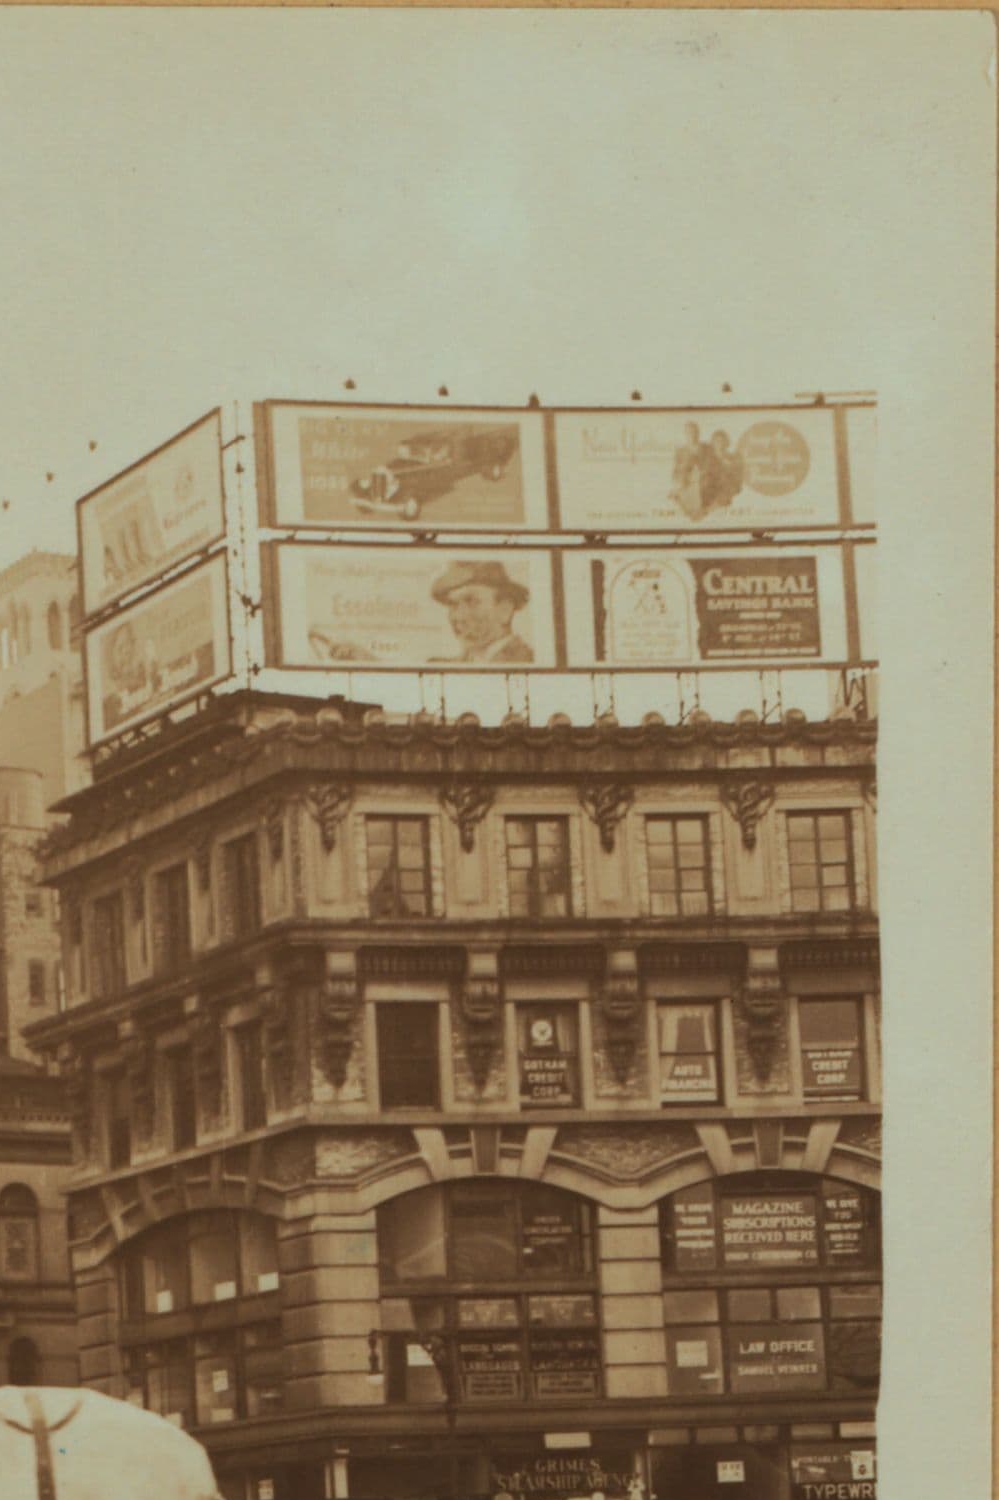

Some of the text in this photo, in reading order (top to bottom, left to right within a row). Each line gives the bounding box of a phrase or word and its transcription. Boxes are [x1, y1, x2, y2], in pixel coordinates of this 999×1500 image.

[702, 568, 815, 596] CENTRAL
[771, 596, 815, 608] BANK
[524, 1060, 567, 1070] GOTHAM
[812, 1060, 848, 1071] CREDIT
[528, 1073, 564, 1083] CREDIT
[732, 1201, 805, 1215] MAGAZINE
[722, 1216, 817, 1230] SUBSCRIPTIONS
[724, 1231, 782, 1244] RECEIVED
[785, 1230, 816, 1242] HERE
[739, 1340, 815, 1354] LAW OFFICE
[535, 1459, 601, 1473] GRIMES
[496, 1472, 634, 1490] STEAMSHIP AGENC
